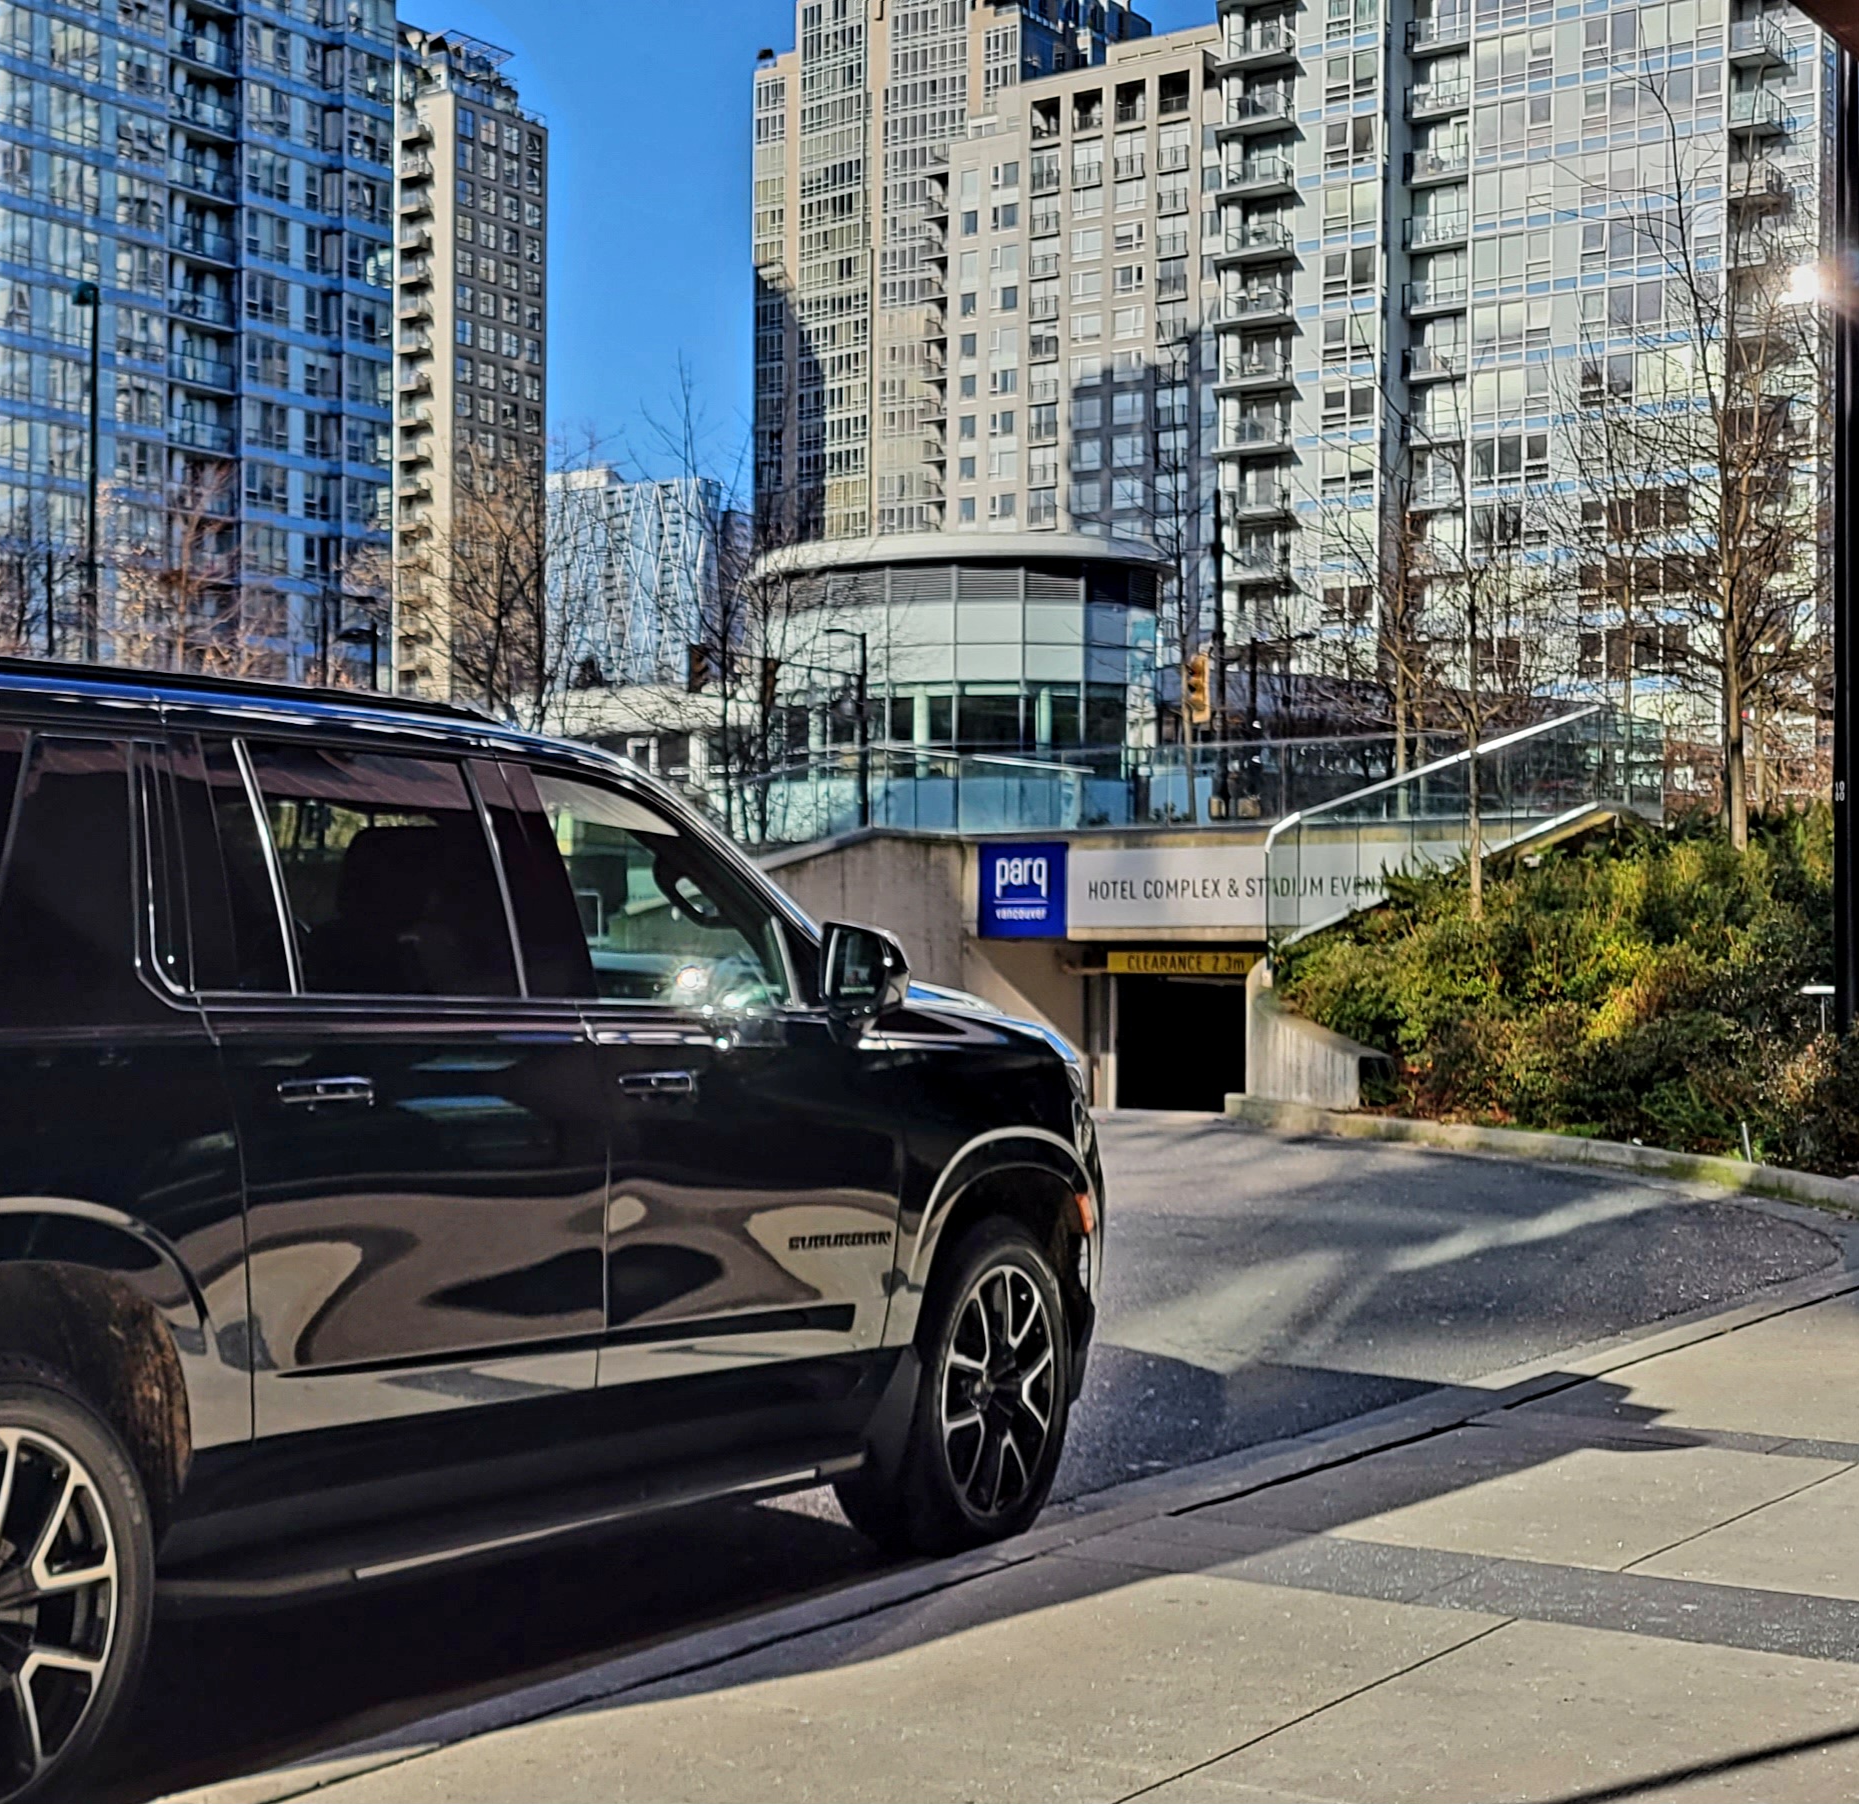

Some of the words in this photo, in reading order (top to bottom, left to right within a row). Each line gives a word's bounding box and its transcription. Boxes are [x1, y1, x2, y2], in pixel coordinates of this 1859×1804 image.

[995, 857, 1047, 898] parq
[1088, 880, 1137, 899] HOTEL
[1143, 878, 1220, 899] COMPLEX
[1227, 879, 1240, 898] &
[1245, 876, 1323, 898] STADIUM
[1127, 954, 1202, 971] CLEARANCE
